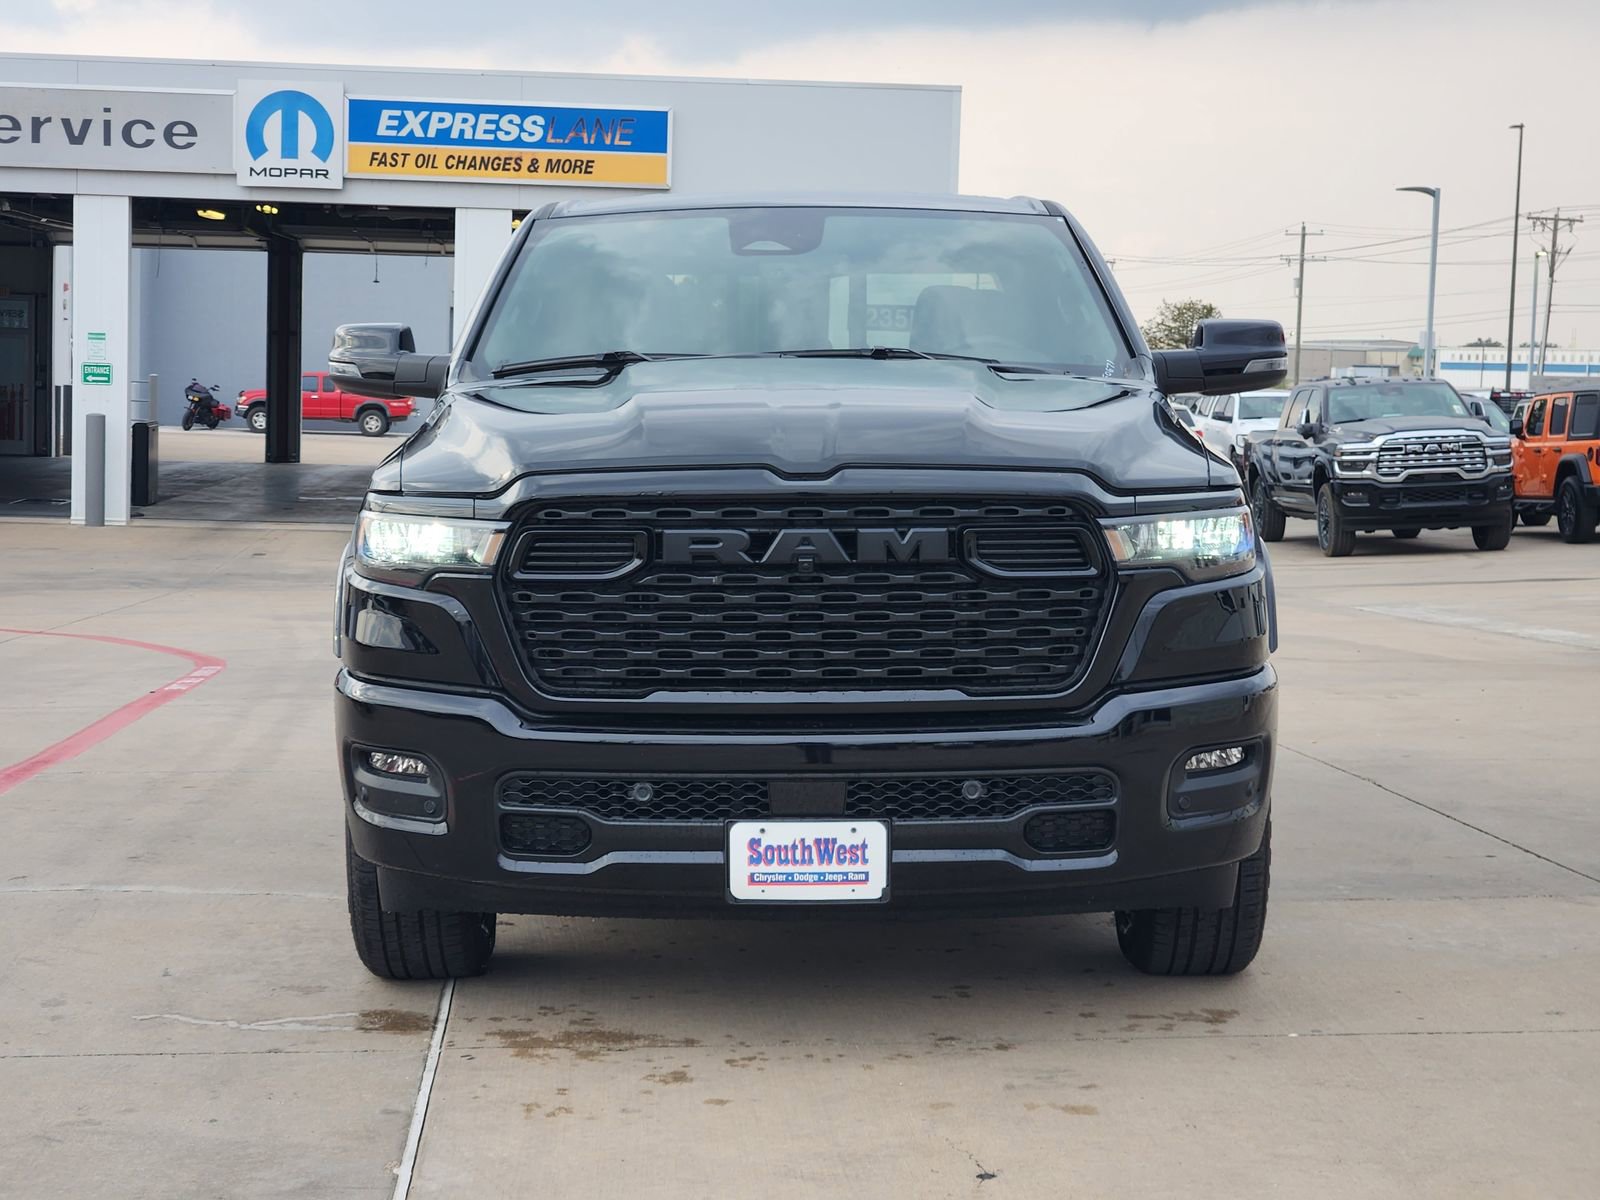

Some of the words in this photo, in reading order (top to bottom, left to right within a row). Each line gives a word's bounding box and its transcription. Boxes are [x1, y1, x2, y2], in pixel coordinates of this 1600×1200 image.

[0, 107, 198, 150] ervice
[369, 152, 410, 168] FAST
[415, 153, 438, 169] OIL
[445, 155, 523, 172] CHANGES
[527, 158, 540, 173] &
[545, 159, 595, 175] MORE
[249, 167, 329, 179] MOPAR
[84, 366, 110, 374] ENTRANCE
[1406, 442, 1460, 454] RAM
[662, 528, 950, 565] RAM
[747, 837, 869, 867] SouthWest
[753, 873, 787, 883] Chrysler
[793, 873, 819, 883] Dodge
[825, 873, 843, 883] Jeep
[848, 872, 866, 881] Ram
